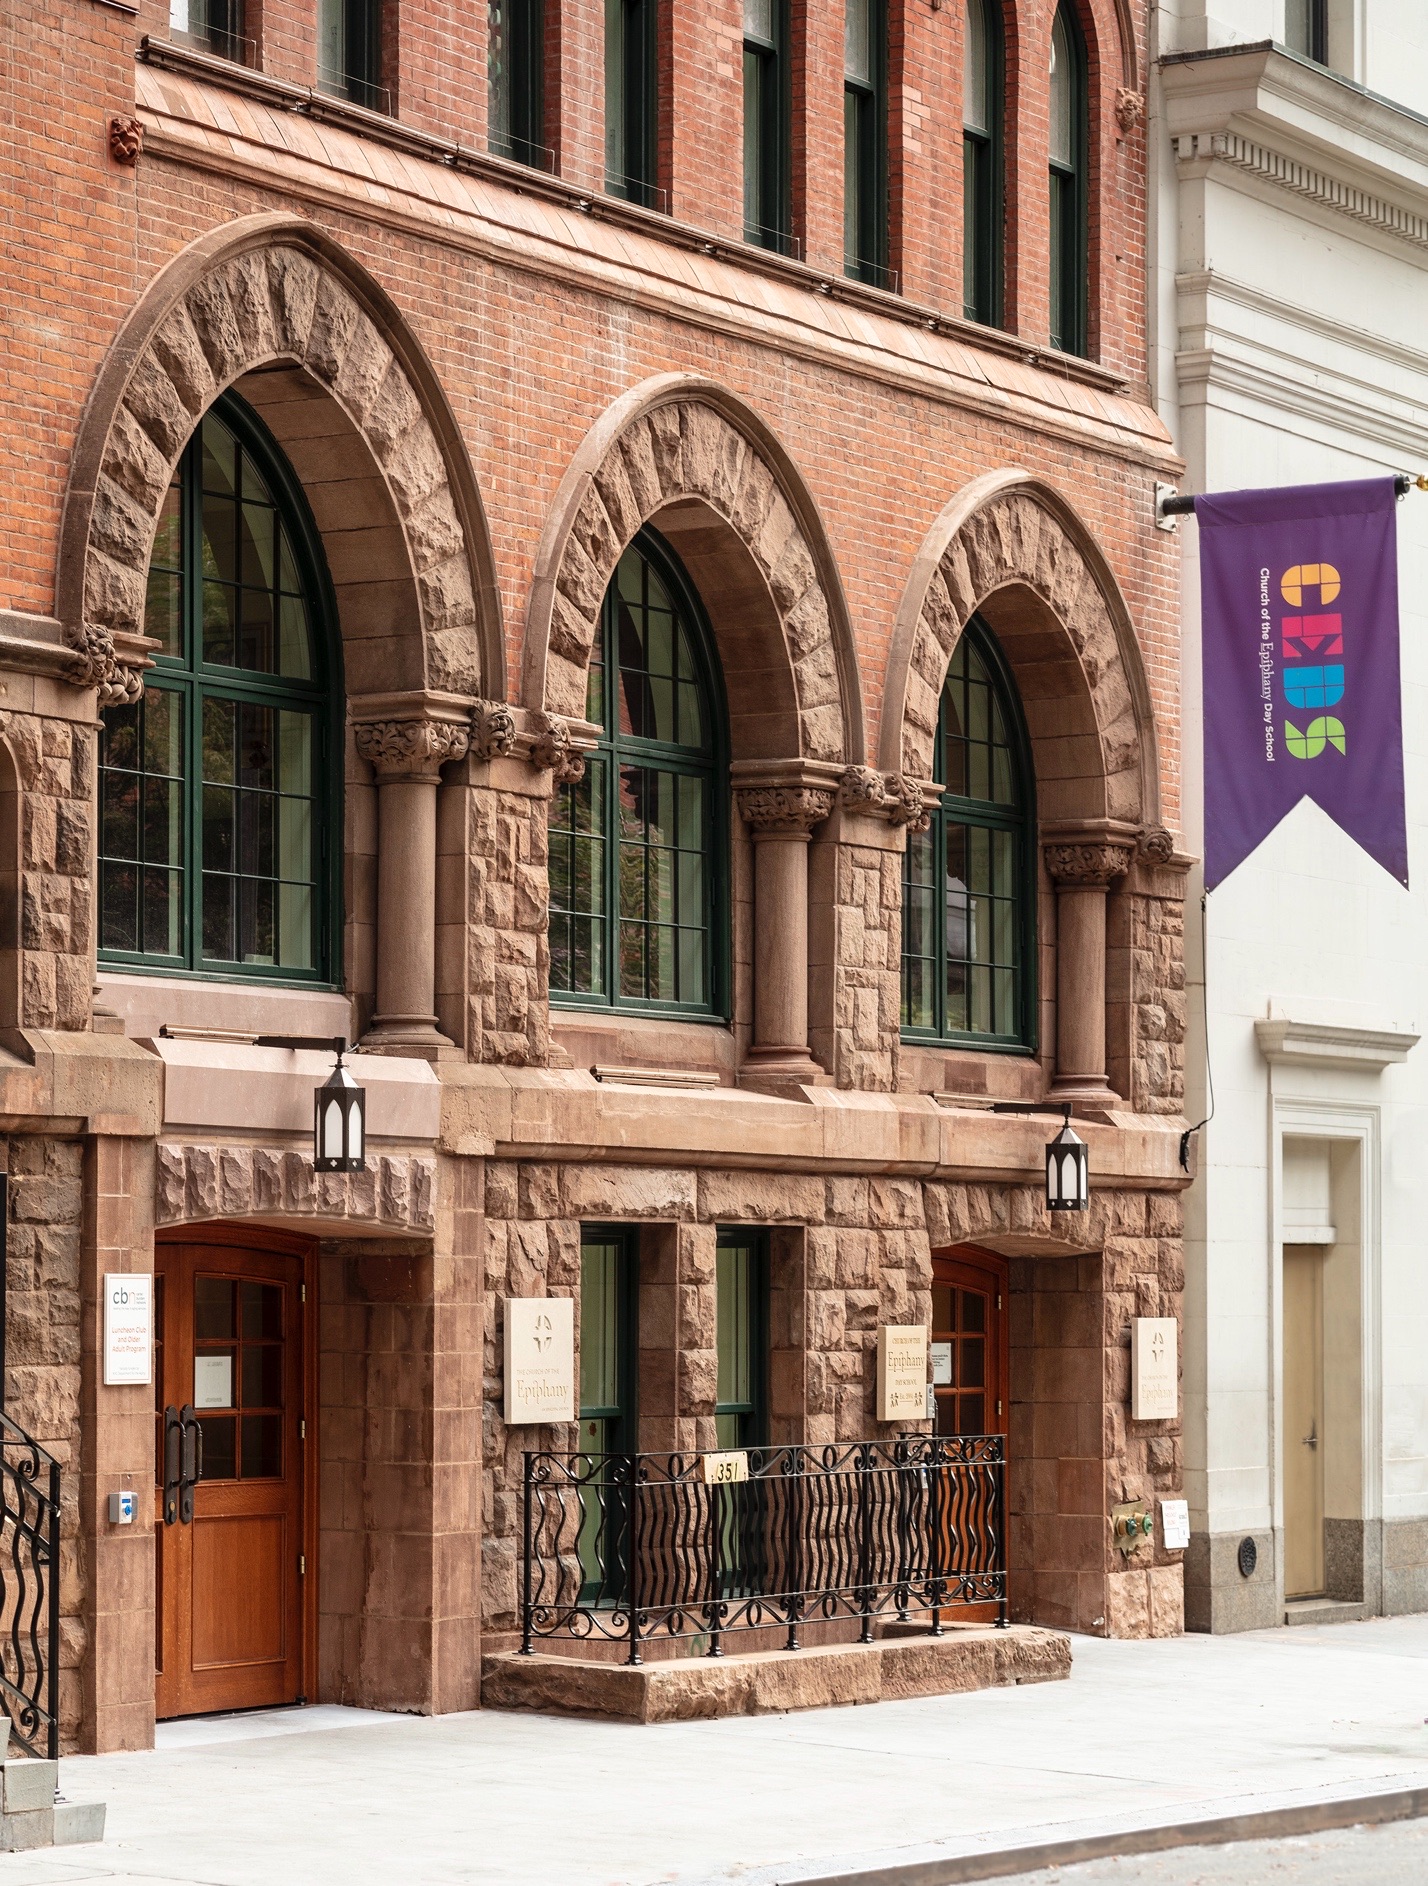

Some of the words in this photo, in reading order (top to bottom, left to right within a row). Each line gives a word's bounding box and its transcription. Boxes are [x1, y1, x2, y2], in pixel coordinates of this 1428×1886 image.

[1260, 567, 1270, 606] Church
[1261, 607, 1271, 620] of
[1262, 620, 1272, 640] the
[1259, 642, 1274, 701] Epiphany
[1263, 703, 1273, 724] Day
[1265, 726, 1275, 762] School
[113, 1287, 135, 1305] cbn
[888, 1351, 924, 1372] Epiphany
[517, 1379, 568, 1405] Epiphany
[718, 1463, 737, 1481] 351
